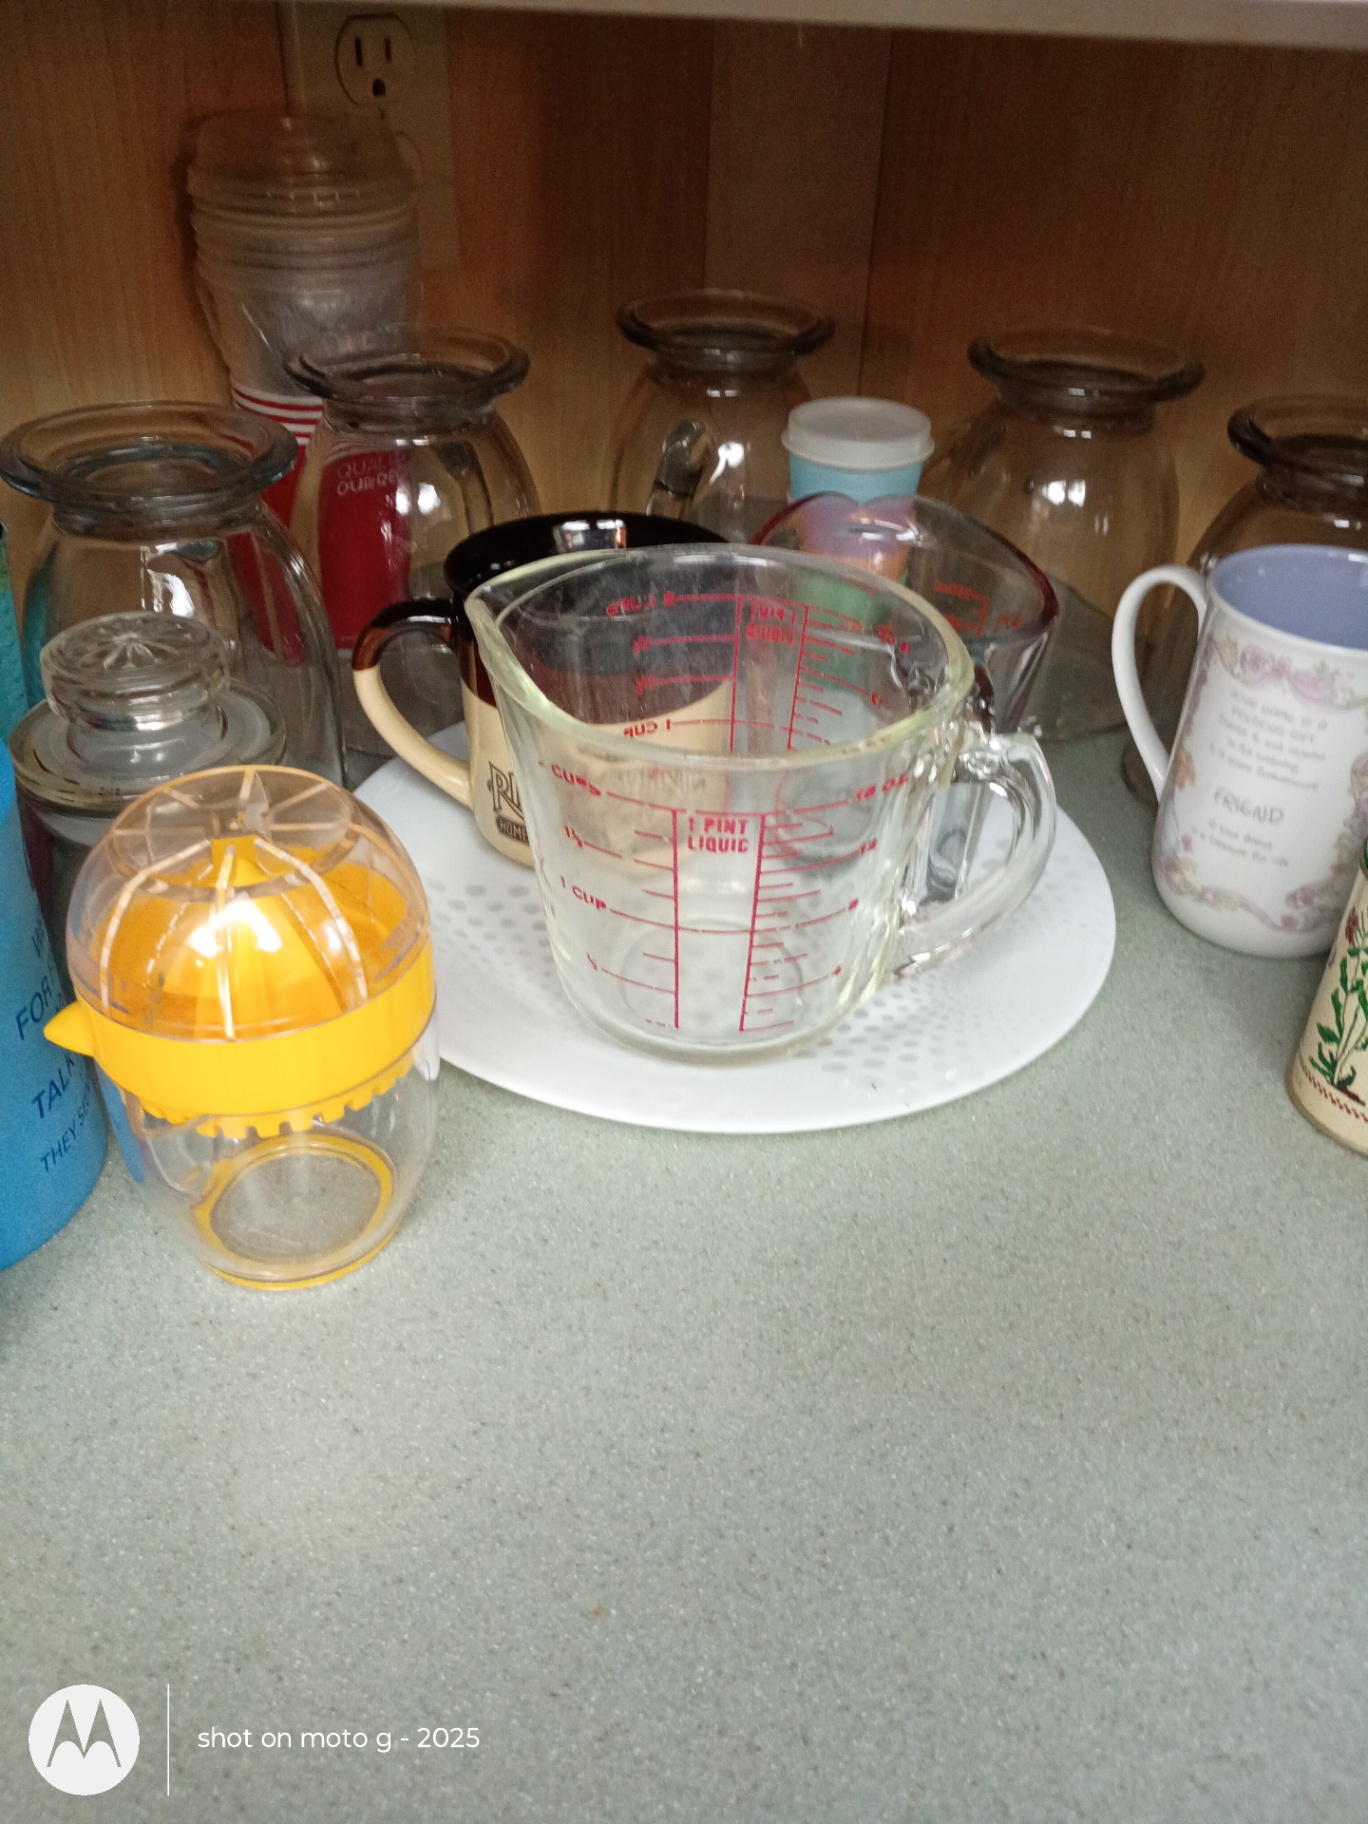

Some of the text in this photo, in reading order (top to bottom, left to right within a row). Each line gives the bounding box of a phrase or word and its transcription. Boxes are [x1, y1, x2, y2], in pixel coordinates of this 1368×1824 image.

[1213, 786, 1285, 826] FRIEND
[703, 817, 748, 835] PINT
[687, 835, 749, 853] LIQUID
[571, 884, 607, 910] CUP
[40, 1119, 77, 1172] THEY
